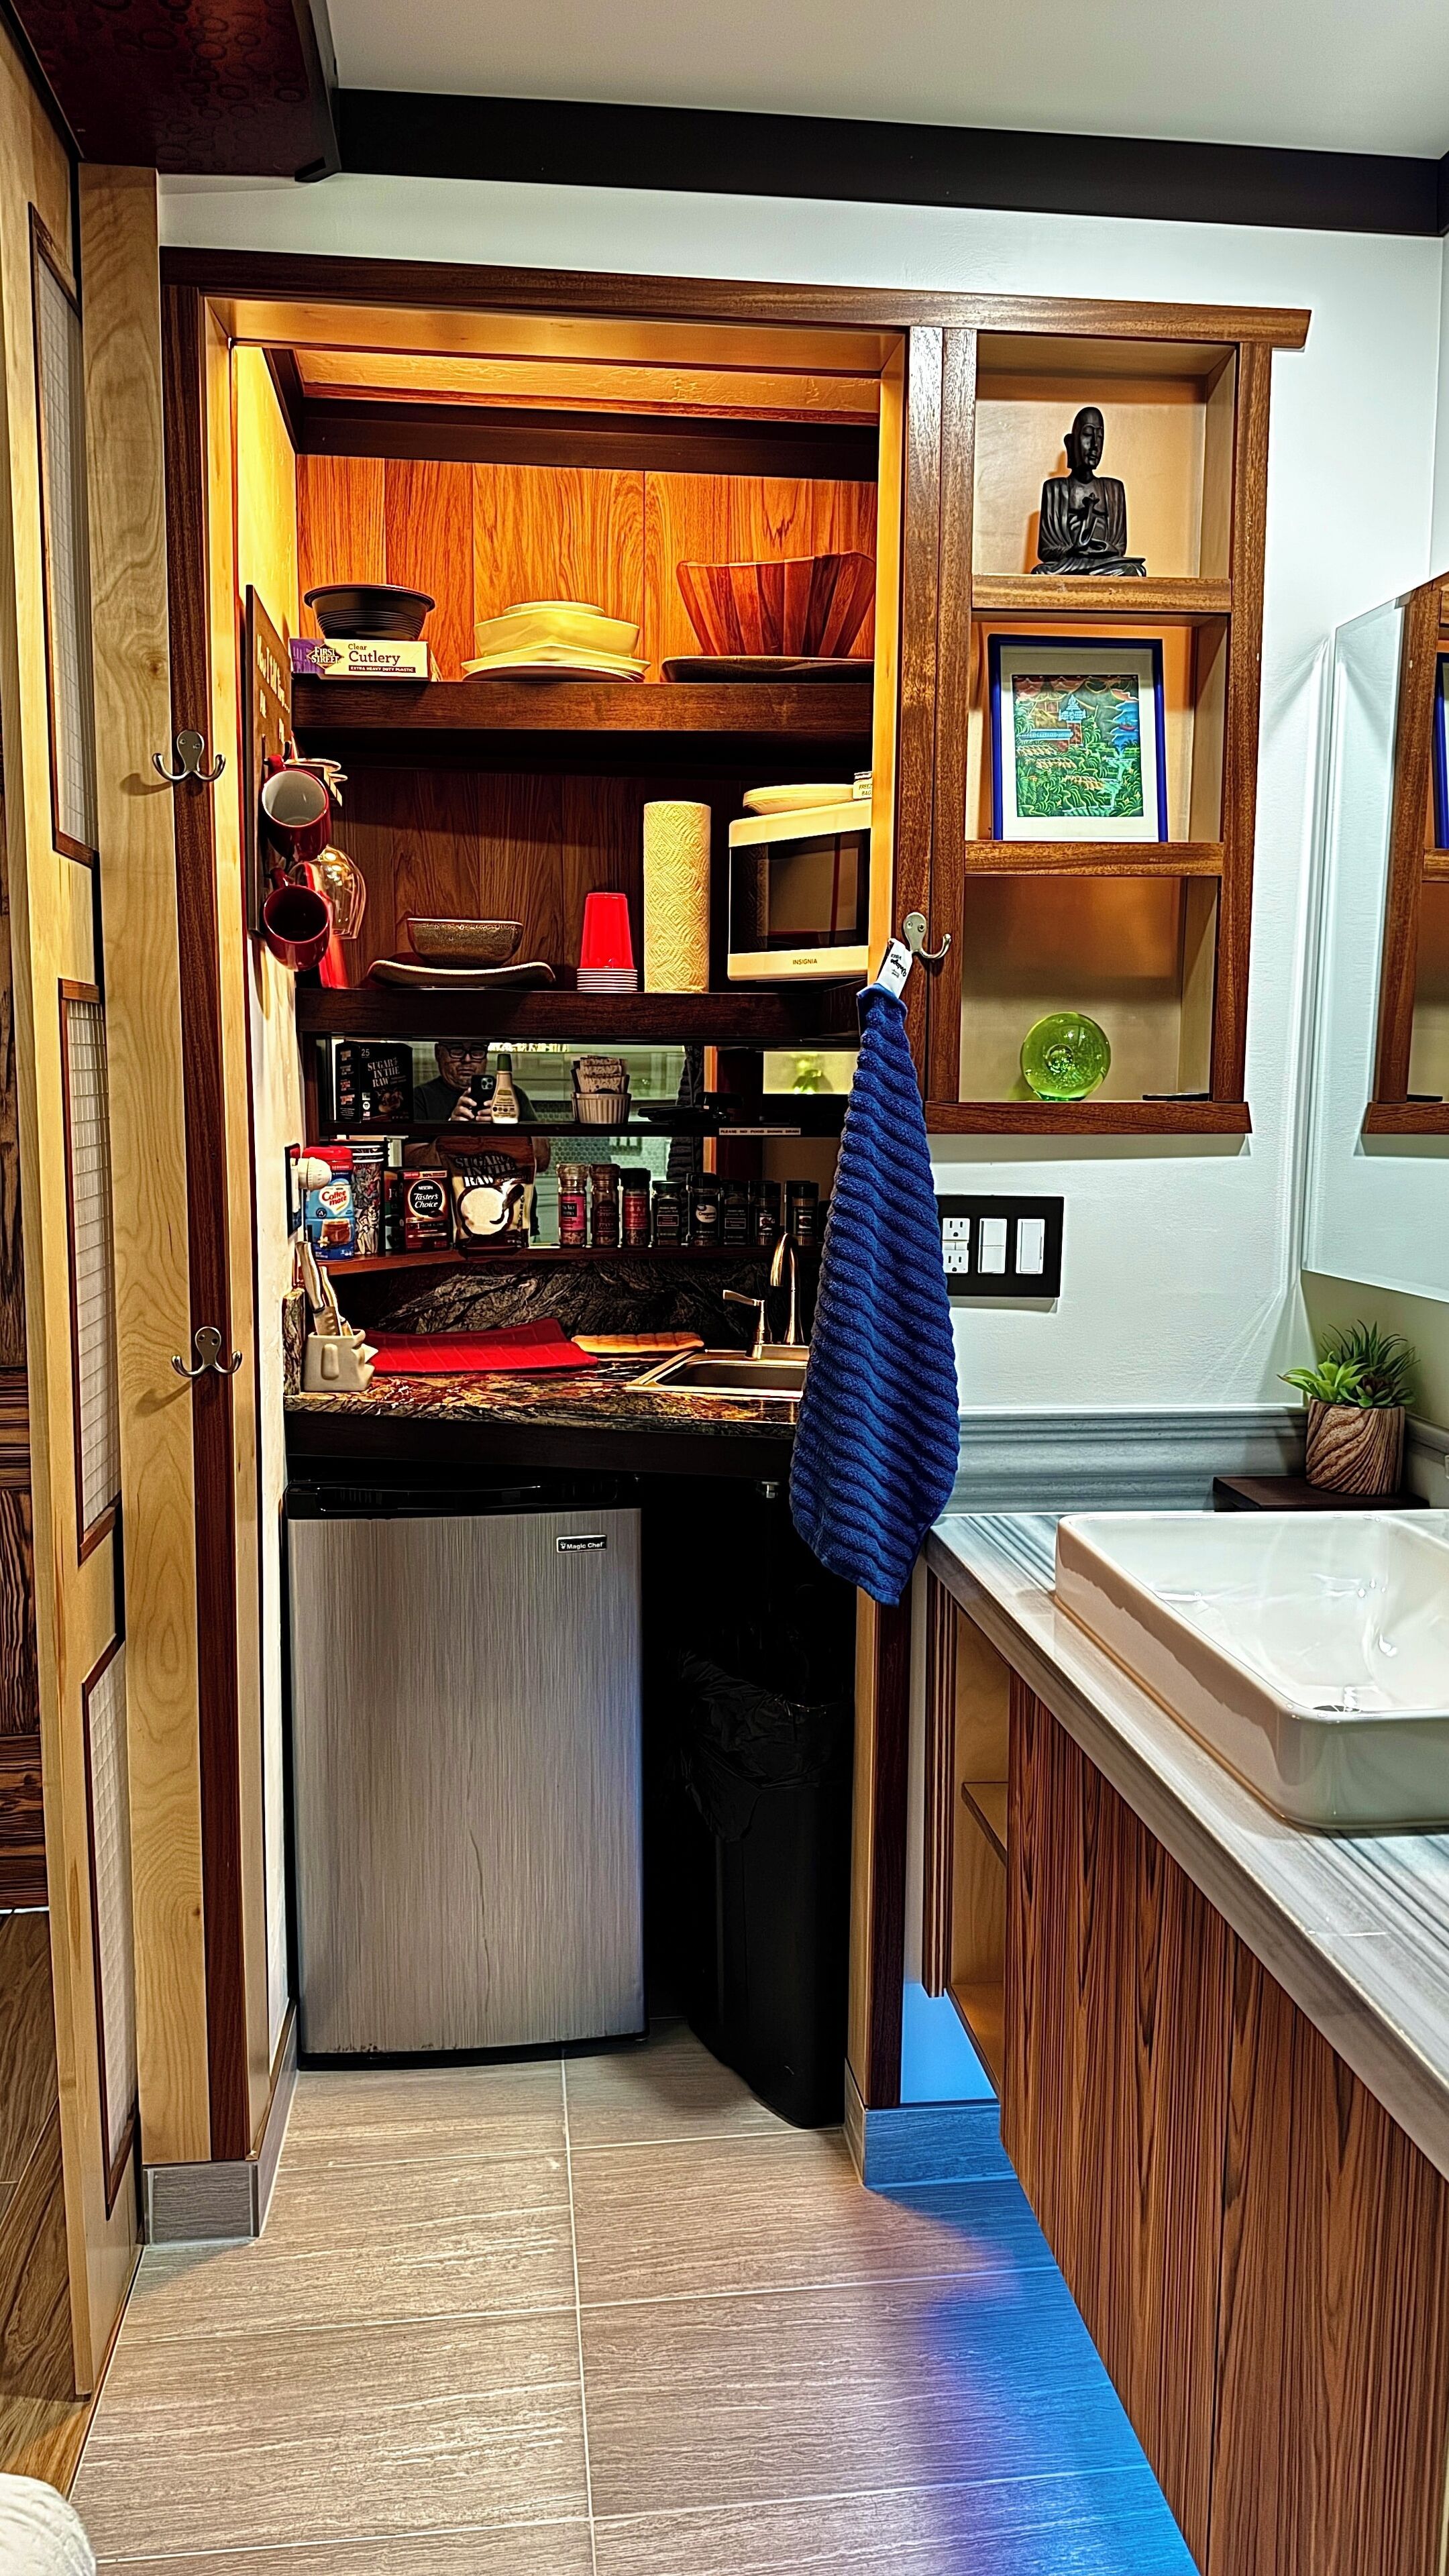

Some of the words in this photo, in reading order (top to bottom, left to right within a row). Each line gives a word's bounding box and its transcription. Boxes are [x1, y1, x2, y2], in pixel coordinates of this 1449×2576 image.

[315, 647, 336, 656] FIRST
[311, 655, 339, 663] STREET
[349, 650, 400, 666] Cutlery
[362, 1049, 370, 1057] 25
[368, 1059, 393, 1071] SUGAR
[374, 1070, 382, 1079] IN
[384, 1066, 400, 1076] THE
[372, 1077, 390, 1087] RAW
[455, 1155, 502, 1167] SUGAR
[464, 1175, 494, 1187] RAW
[322, 1190, 346, 1201] Coffee
[329, 1195, 347, 1206] mate
